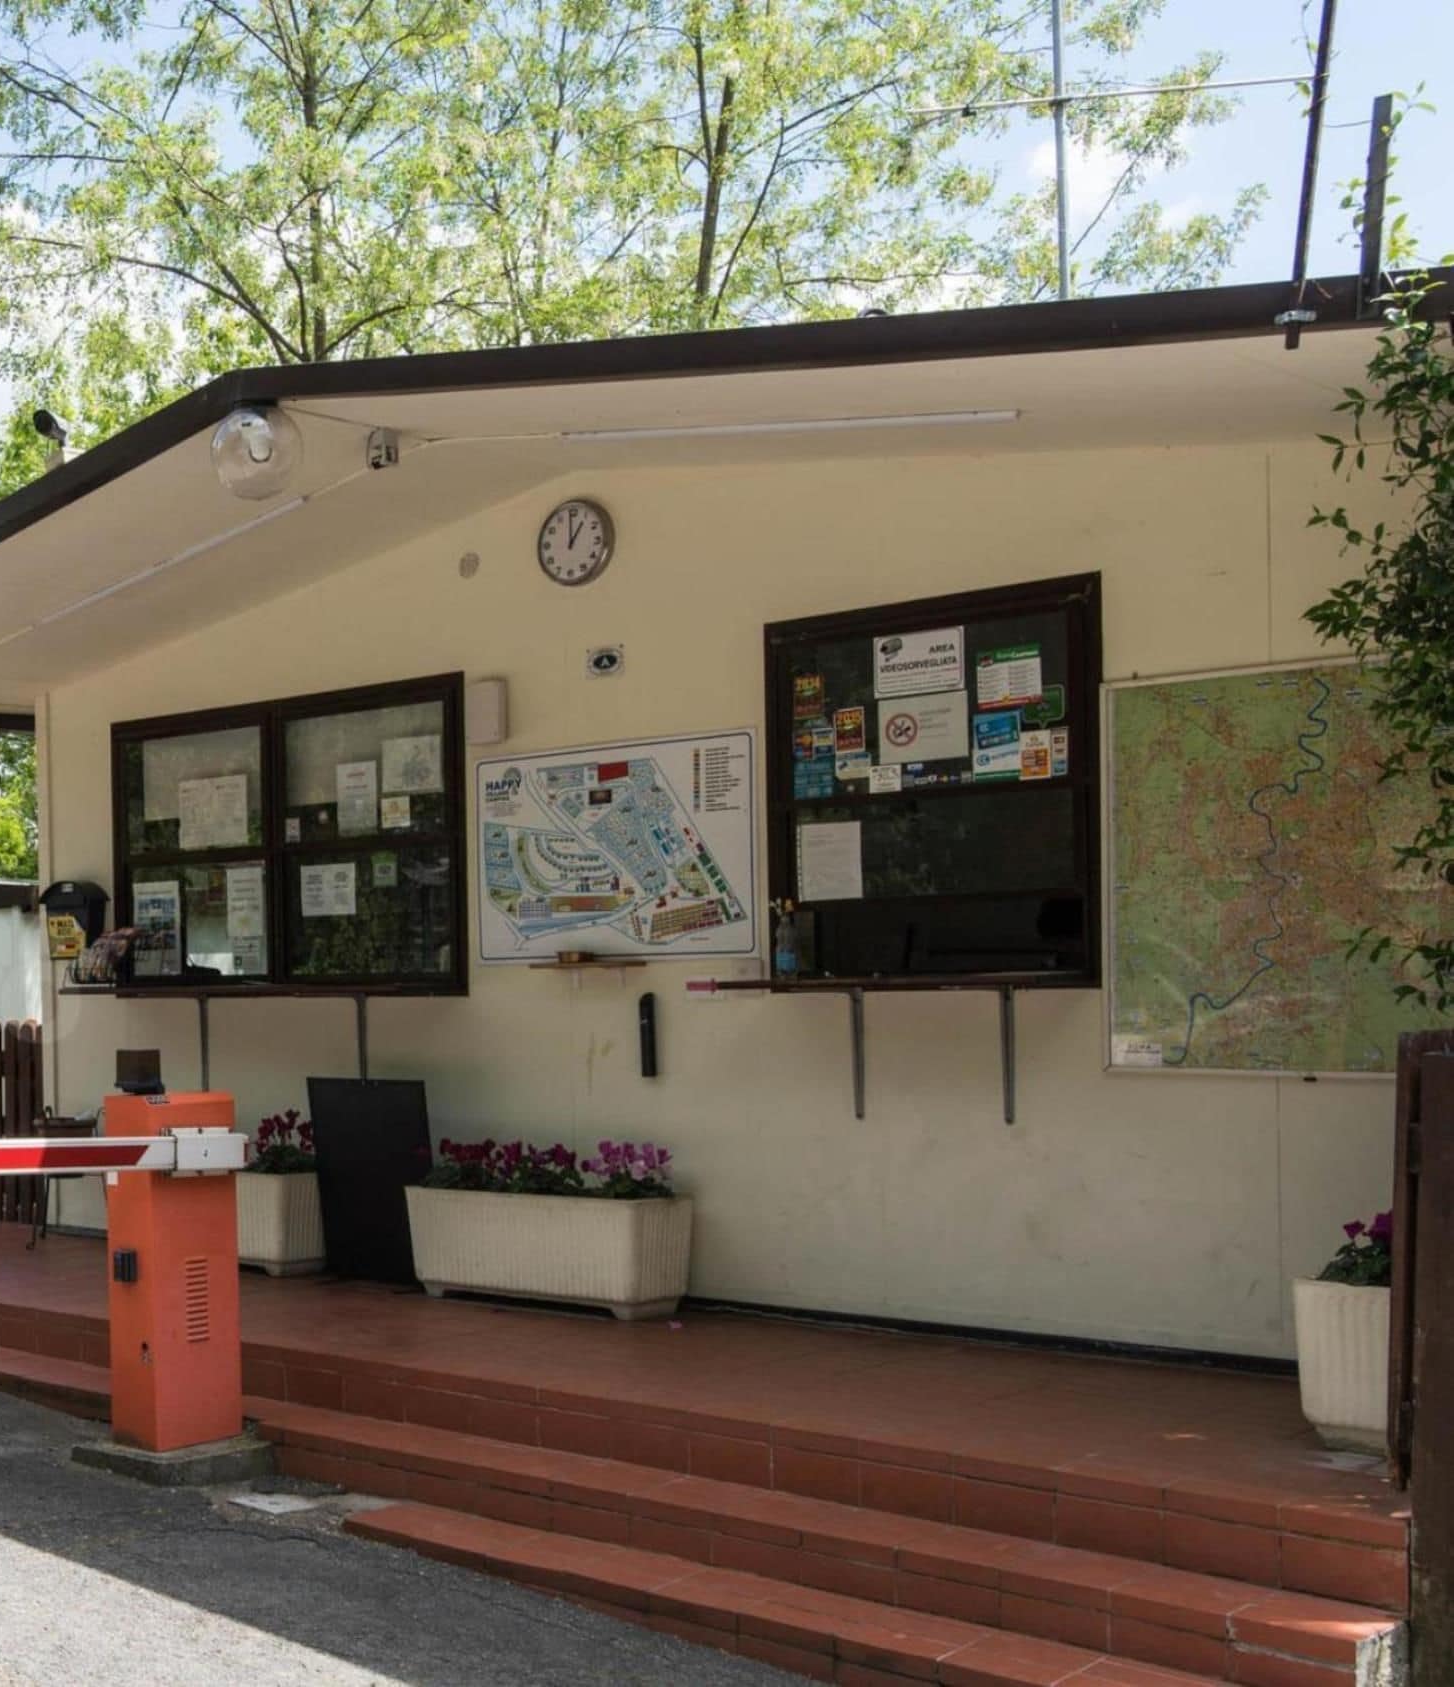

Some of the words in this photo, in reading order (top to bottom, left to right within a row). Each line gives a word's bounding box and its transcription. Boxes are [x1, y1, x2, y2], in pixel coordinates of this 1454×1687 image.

[929, 643, 955, 654] AREA
[879, 655, 957, 673] VIDEOSORVEGLIATA
[485, 776, 522, 790] HAPPY
